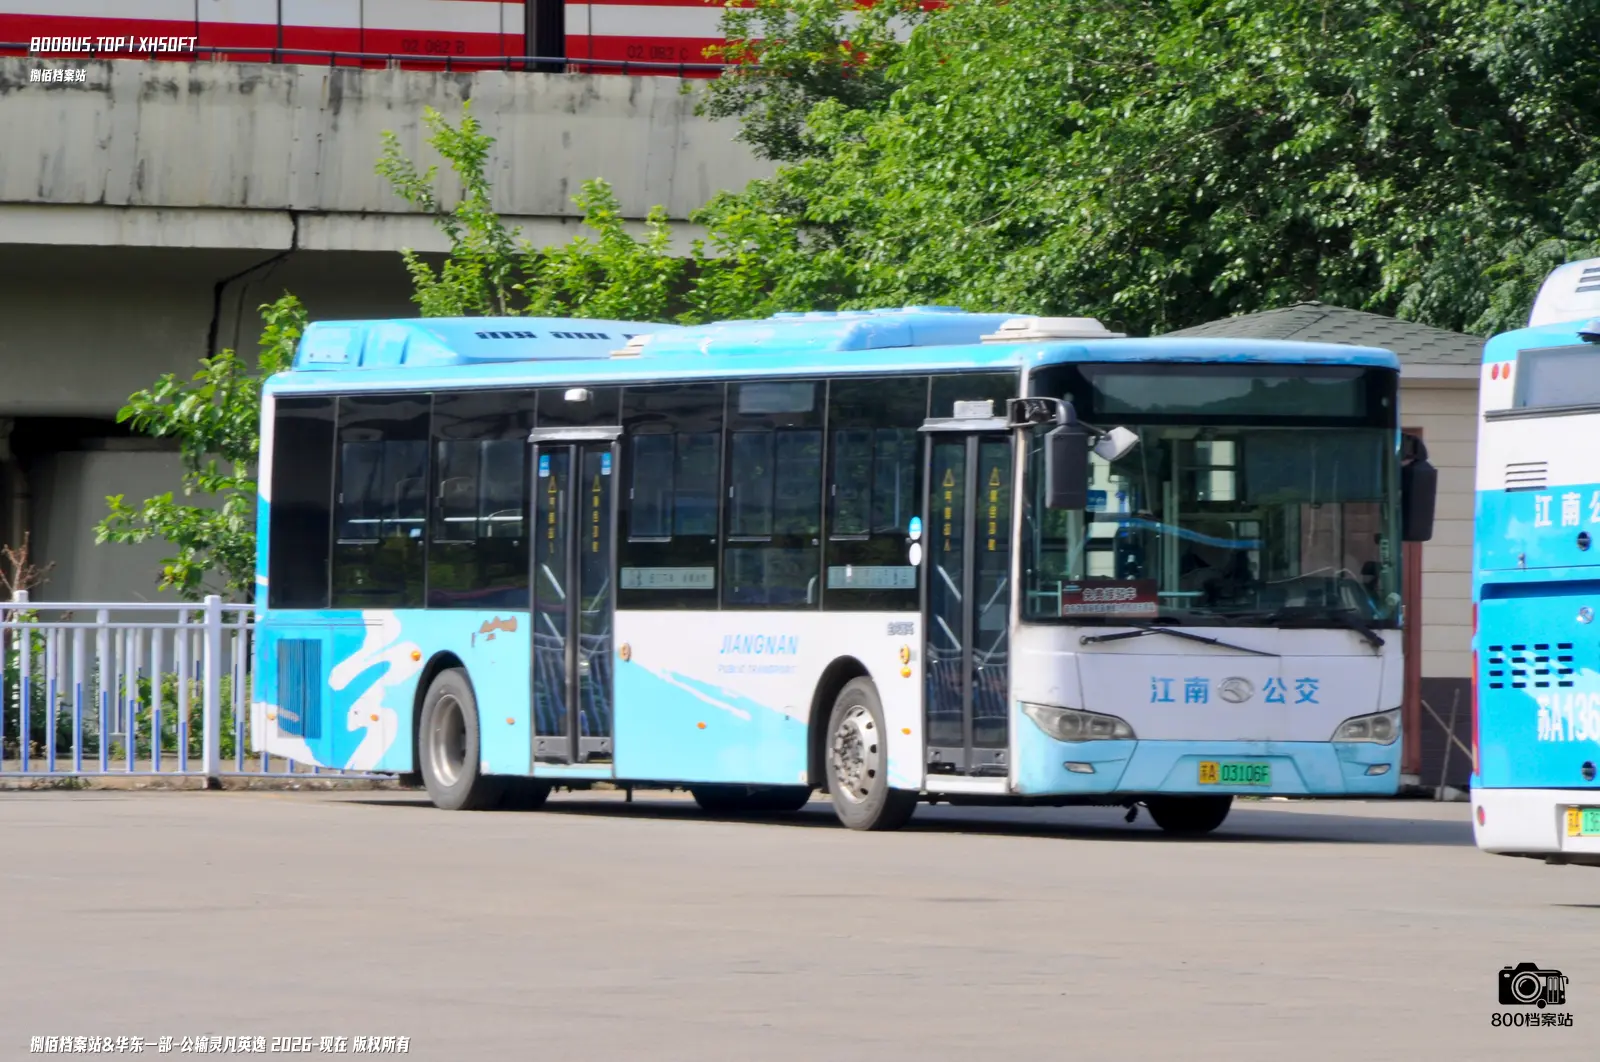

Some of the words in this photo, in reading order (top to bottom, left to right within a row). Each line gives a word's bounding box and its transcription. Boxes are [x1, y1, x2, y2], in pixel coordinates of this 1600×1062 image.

[719, 634, 800, 655] JIANGNAN
[1150, 676, 1210, 705] 江南
[1262, 677, 1320, 705] 公交
